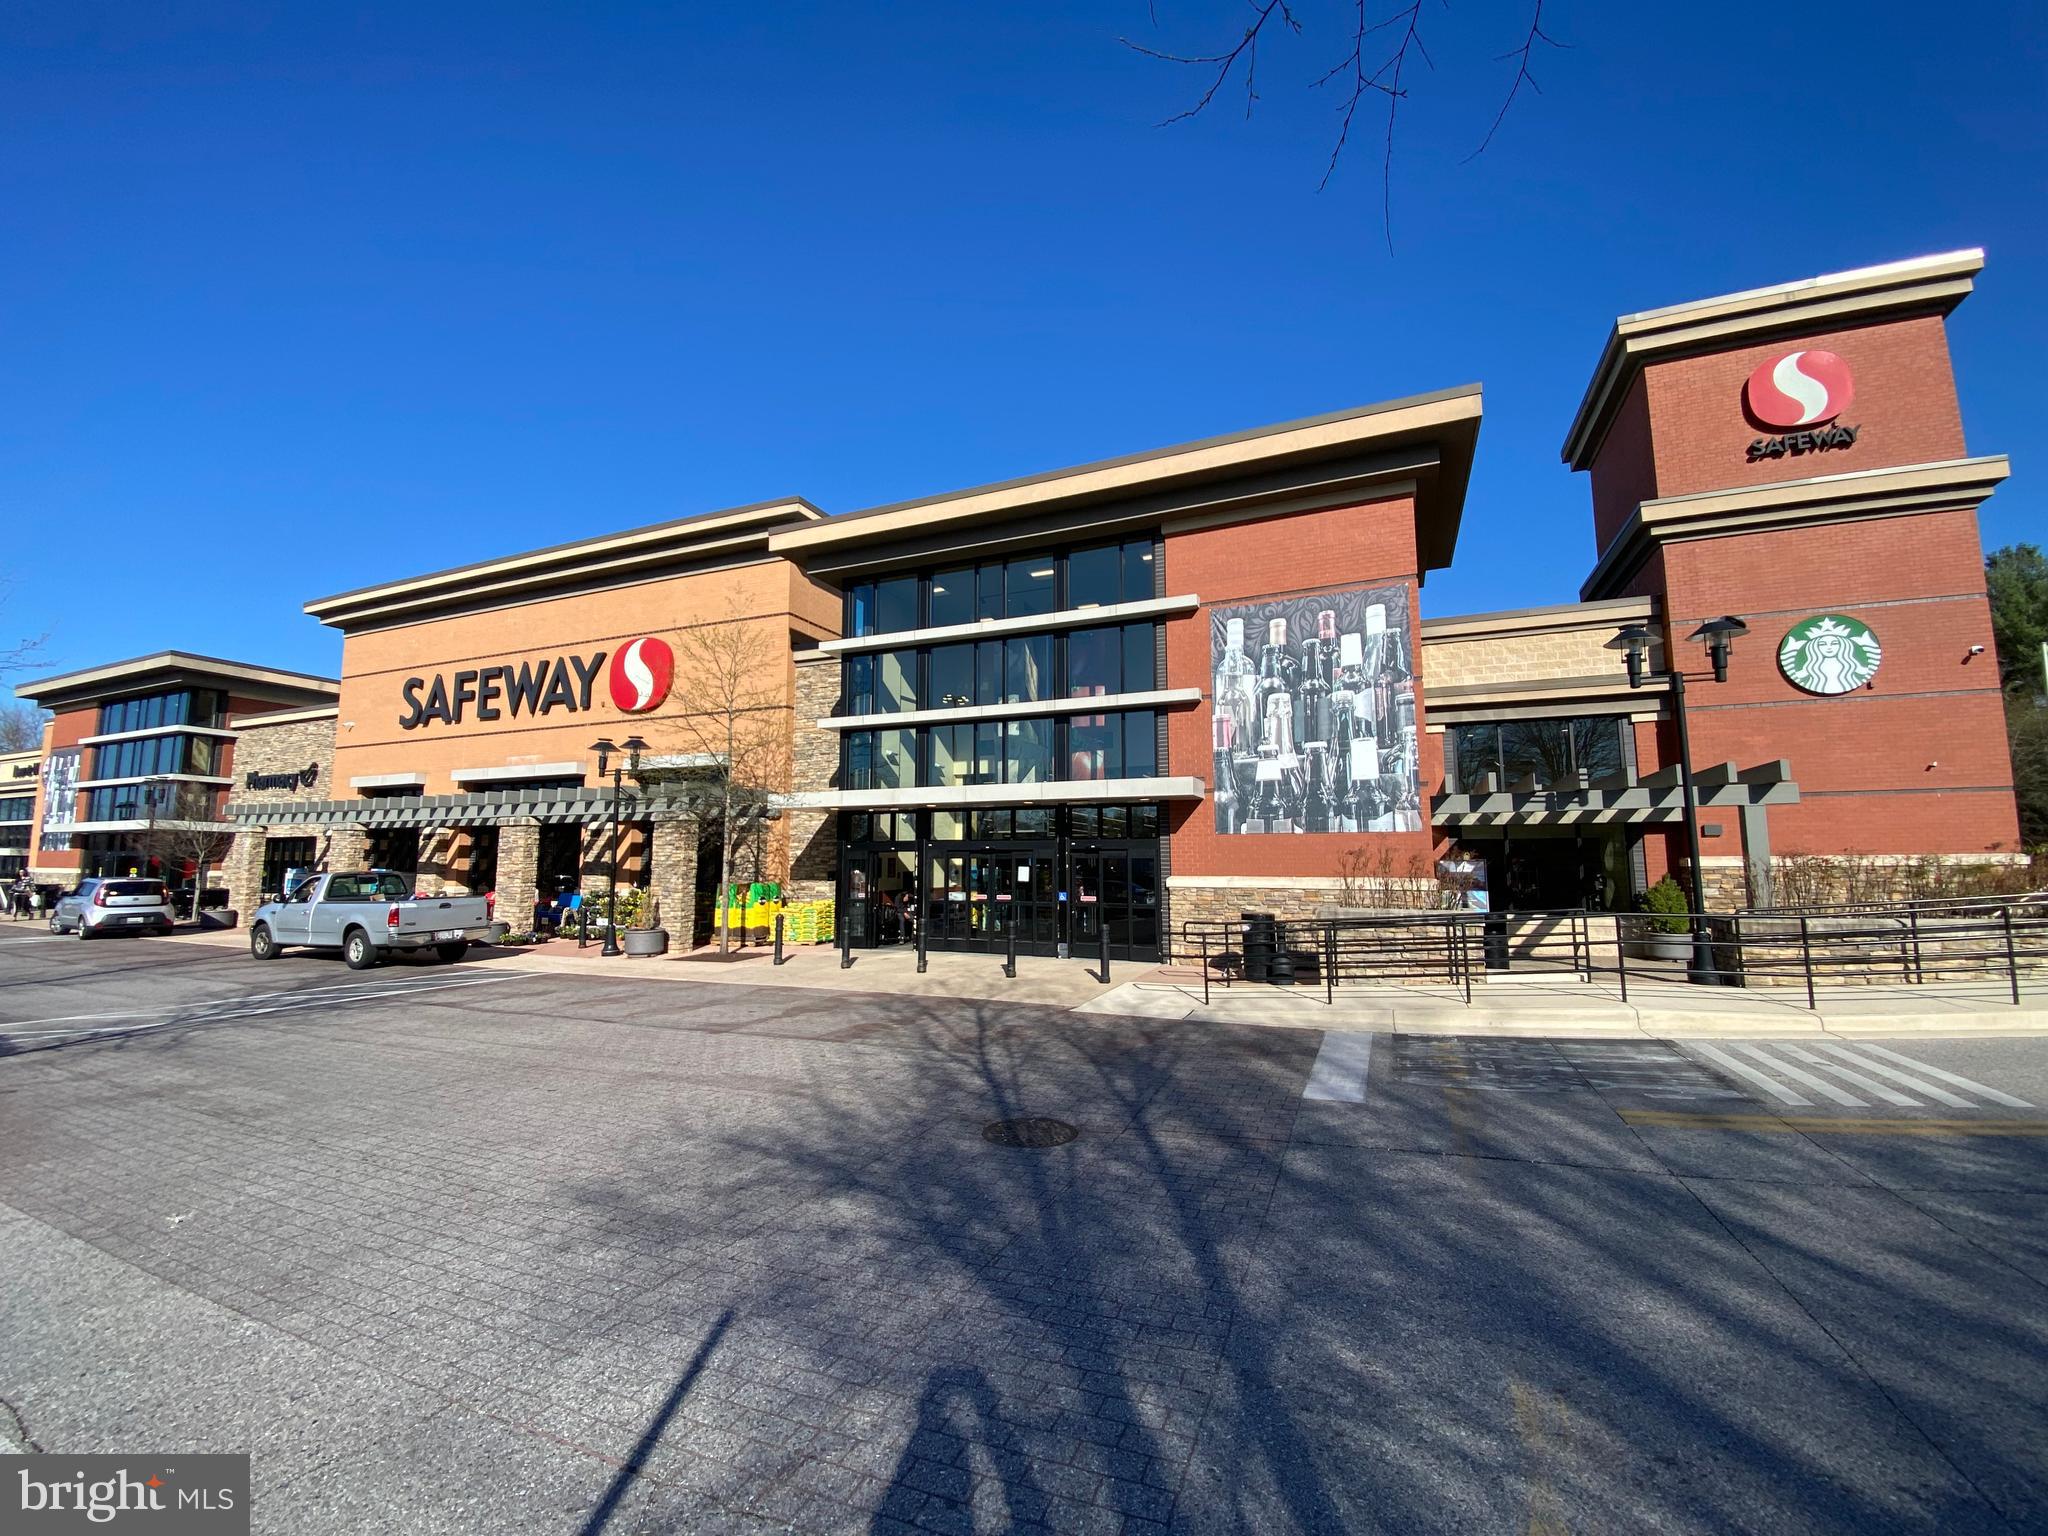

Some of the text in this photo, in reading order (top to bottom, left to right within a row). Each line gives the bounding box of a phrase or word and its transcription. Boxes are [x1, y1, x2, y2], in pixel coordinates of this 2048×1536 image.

[1750, 423, 1861, 458] SAFEWAY
[399, 652, 607, 730] SAFEWAY
[246, 771, 299, 793] Pharmacy
